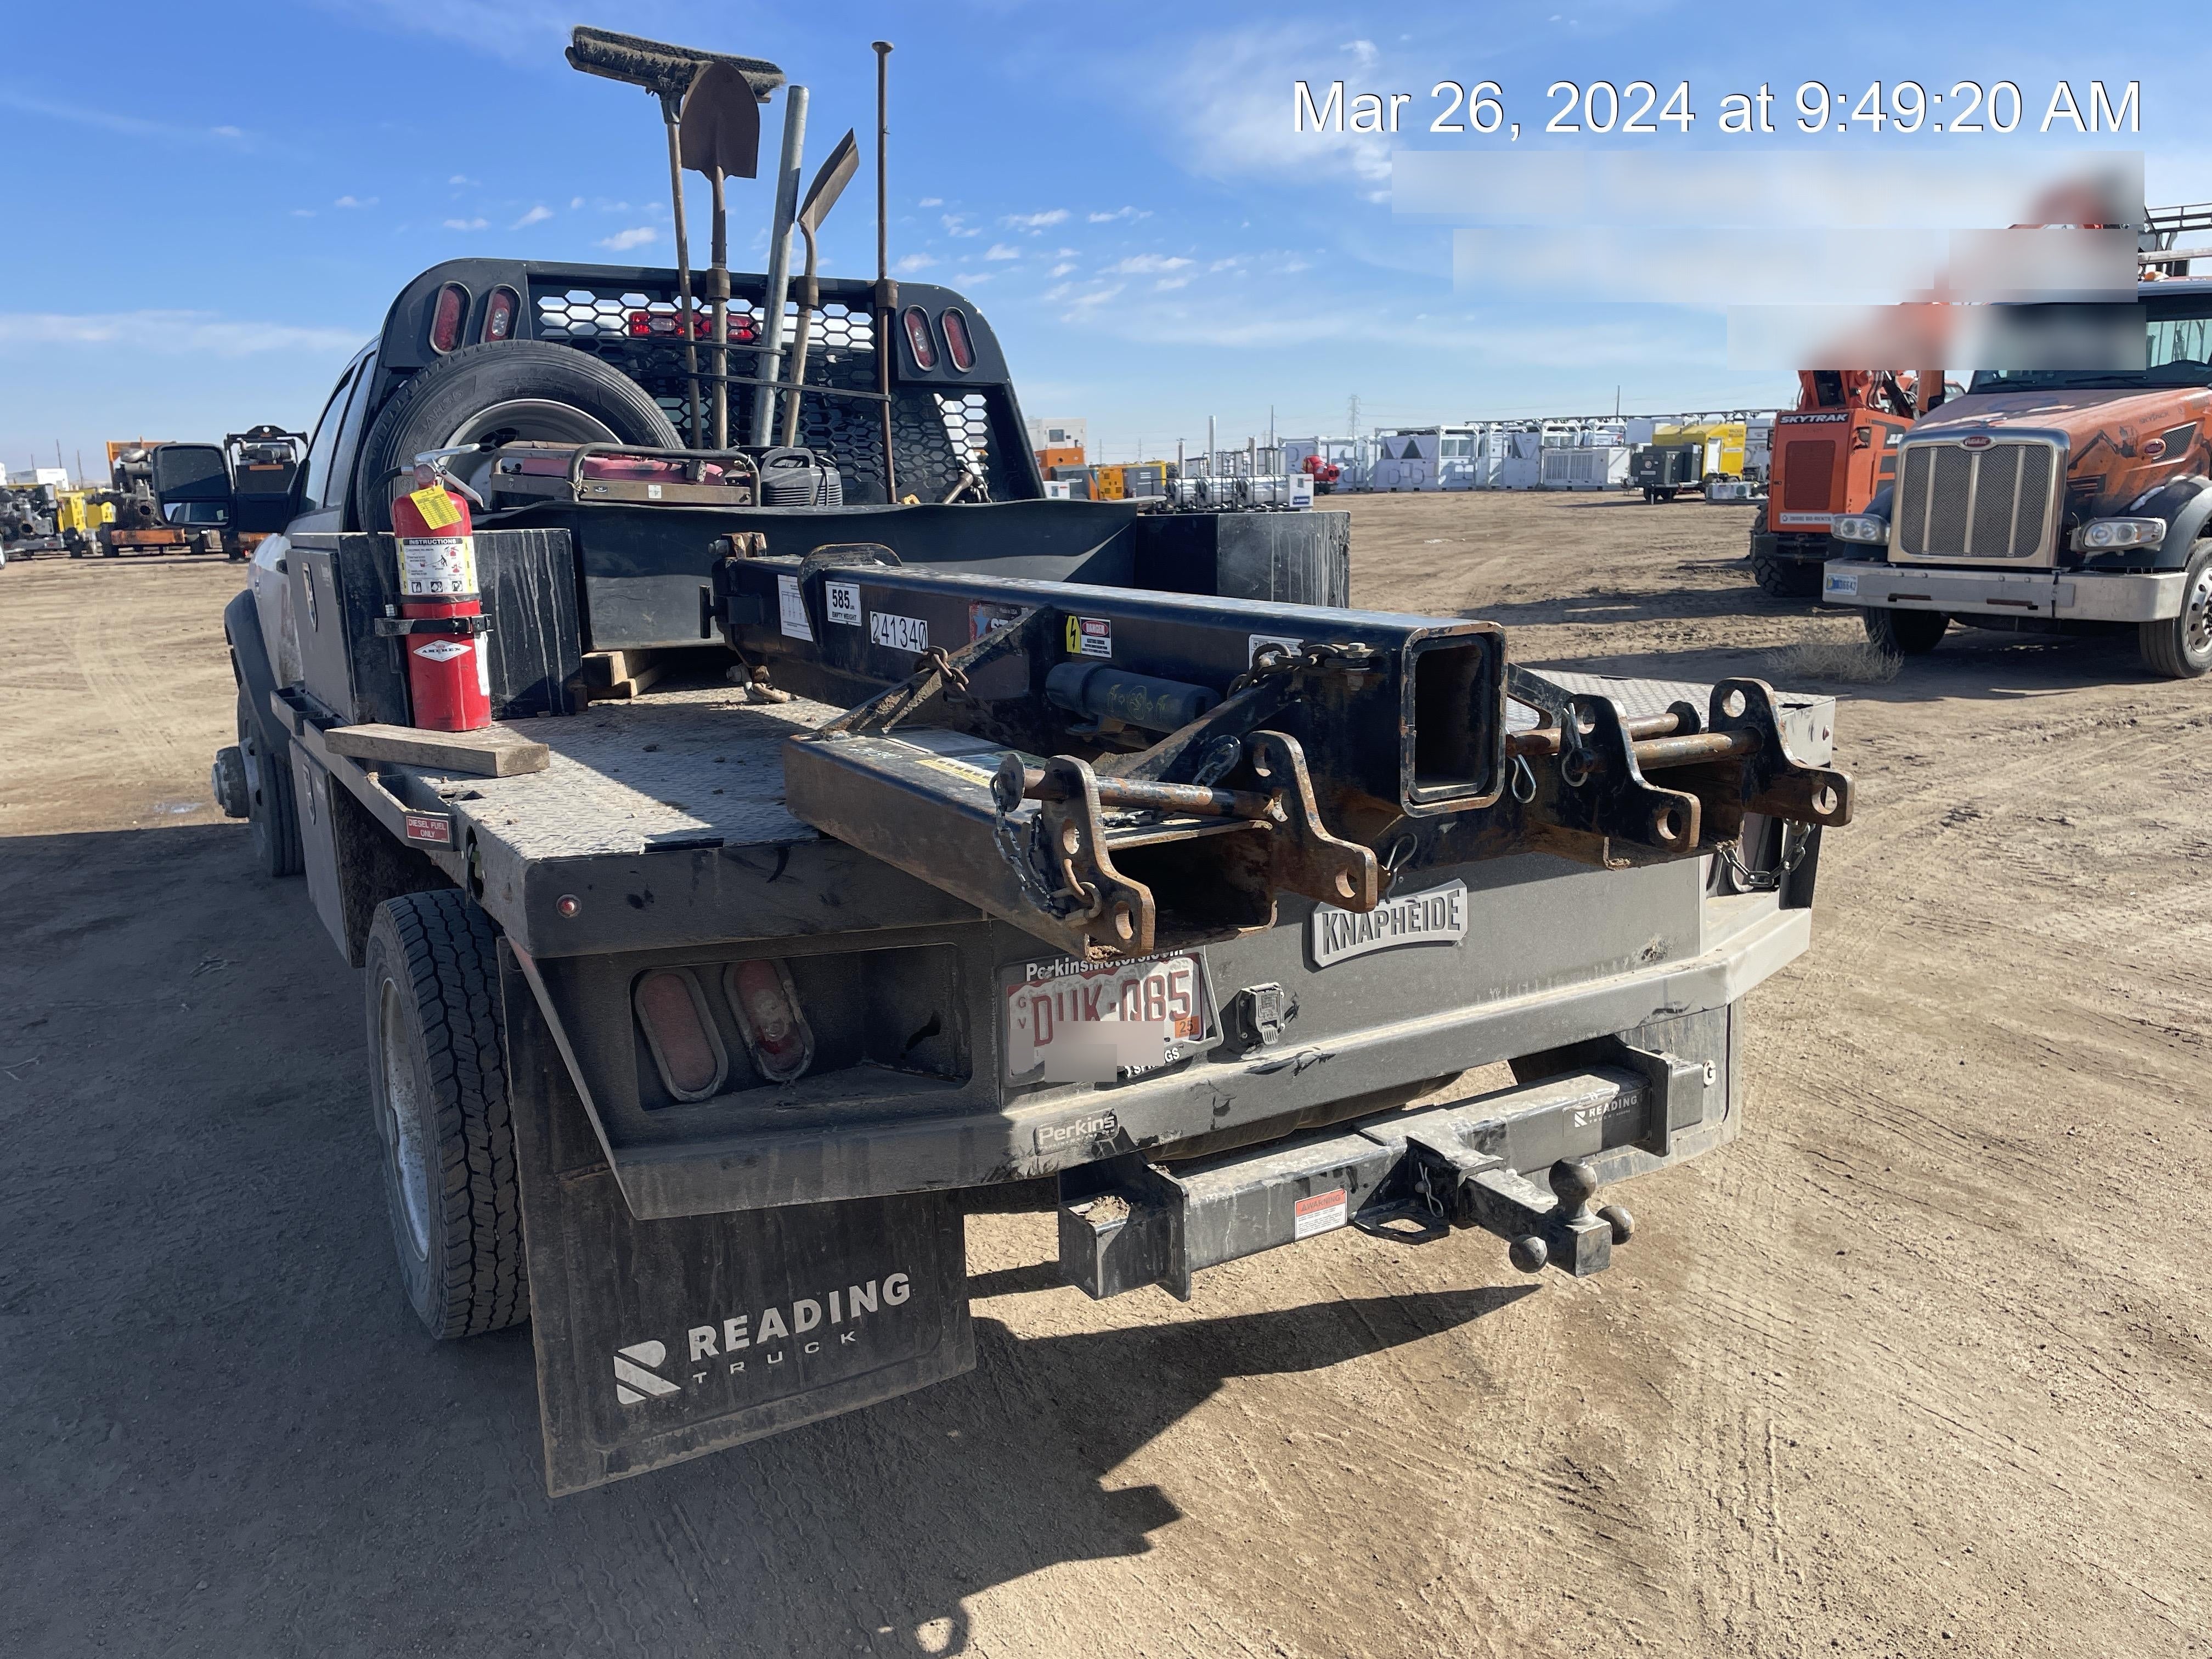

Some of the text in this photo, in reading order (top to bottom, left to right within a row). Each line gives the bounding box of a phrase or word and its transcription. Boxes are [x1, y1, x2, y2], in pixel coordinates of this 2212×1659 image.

[1780, 413, 1848, 424] SKYTRAK
[832, 589, 850, 610] 585
[871, 612, 928, 651] 241340
[408, 819, 447, 831] DIESEL FUEL
[420, 829, 435, 838] ONLY
[1322, 889, 1460, 956] KNAPHEIDE
[1589, 1095, 1638, 1118] READING
[1039, 1115, 1115, 1146] Perkins
[1306, 1194, 1341, 1209] WARNING
[688, 1272, 911, 1362] READING
[692, 1330, 856, 1385] TRUCK
